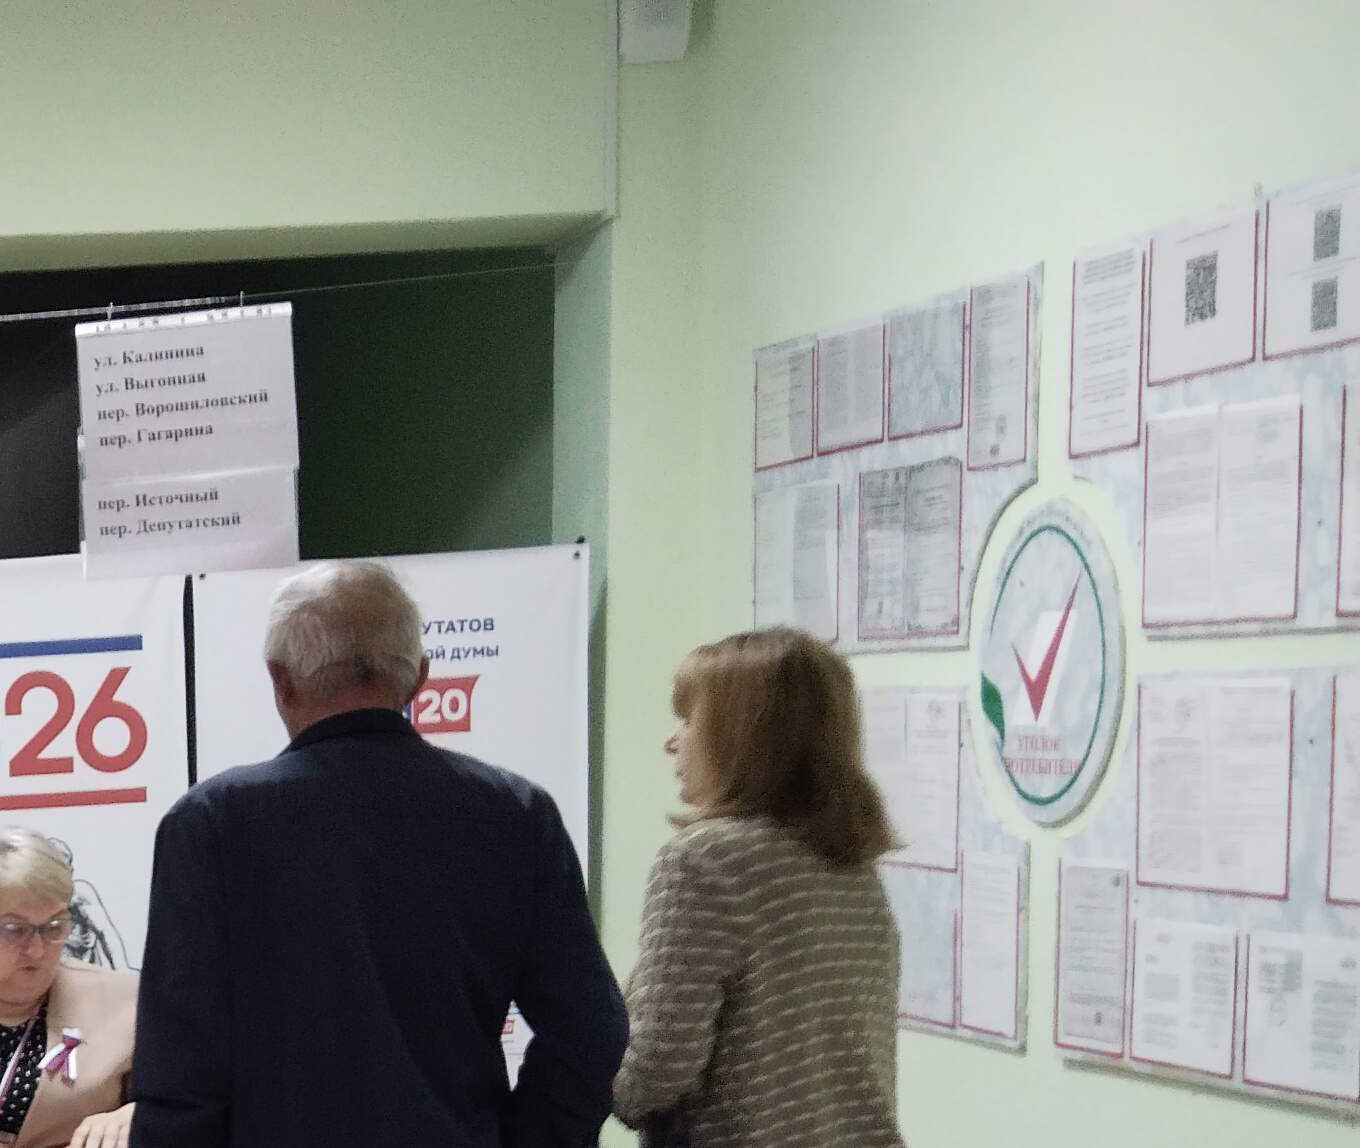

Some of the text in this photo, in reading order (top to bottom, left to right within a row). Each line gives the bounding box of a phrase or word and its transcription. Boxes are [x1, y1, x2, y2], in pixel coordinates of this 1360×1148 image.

[94, 346, 204, 370] ул. Калинина
[96, 372, 206, 396] ул. Выгонная
[97, 390, 268, 422] пер. Ворошиловский
[100, 424, 213, 448] пер. Гагарина
[98, 498, 130, 511] пер.
[100, 513, 240, 537] пер. Депутатский
[422, 618, 494, 635] УТАТОВ
[450, 645, 498, 662] ДУМЫ
[418, 689, 467, 724] 20
